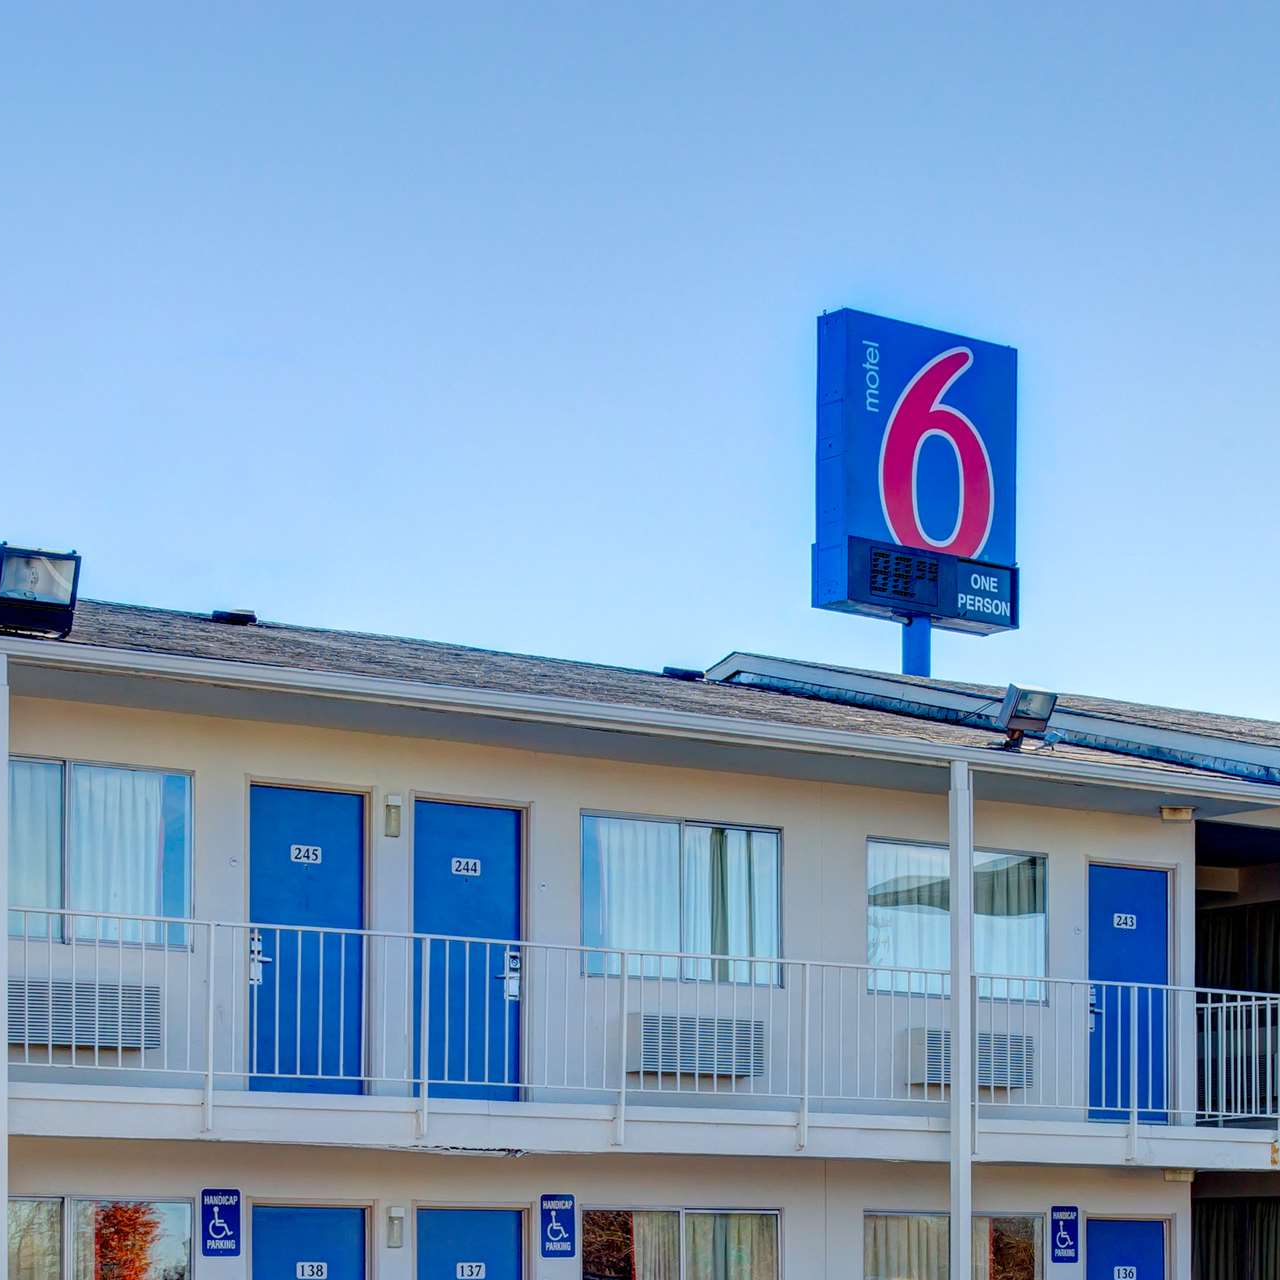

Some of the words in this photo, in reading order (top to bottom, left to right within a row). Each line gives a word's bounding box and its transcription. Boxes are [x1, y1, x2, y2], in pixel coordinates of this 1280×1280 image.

[862, 339, 880, 412] motel
[878, 346, 995, 559] 6
[971, 574, 998, 592] ONE
[958, 593, 1011, 616] PERSON
[294, 847, 319, 862] 245
[455, 859, 478, 874] 244
[1116, 915, 1134, 928] 243
[203, 1195, 238, 1206] HANDICAP
[542, 1200, 573, 1210] HANDICAP
[1052, 1211, 1077, 1220] HANDICAP
[206, 1239, 236, 1249] PARKING
[545, 1241, 571, 1251] PARKING
[1054, 1248, 1075, 1257] PARKING
[299, 1264, 324, 1278] 138
[459, 1264, 482, 1277] 137
[1116, 1268, 1134, 1280] 136
